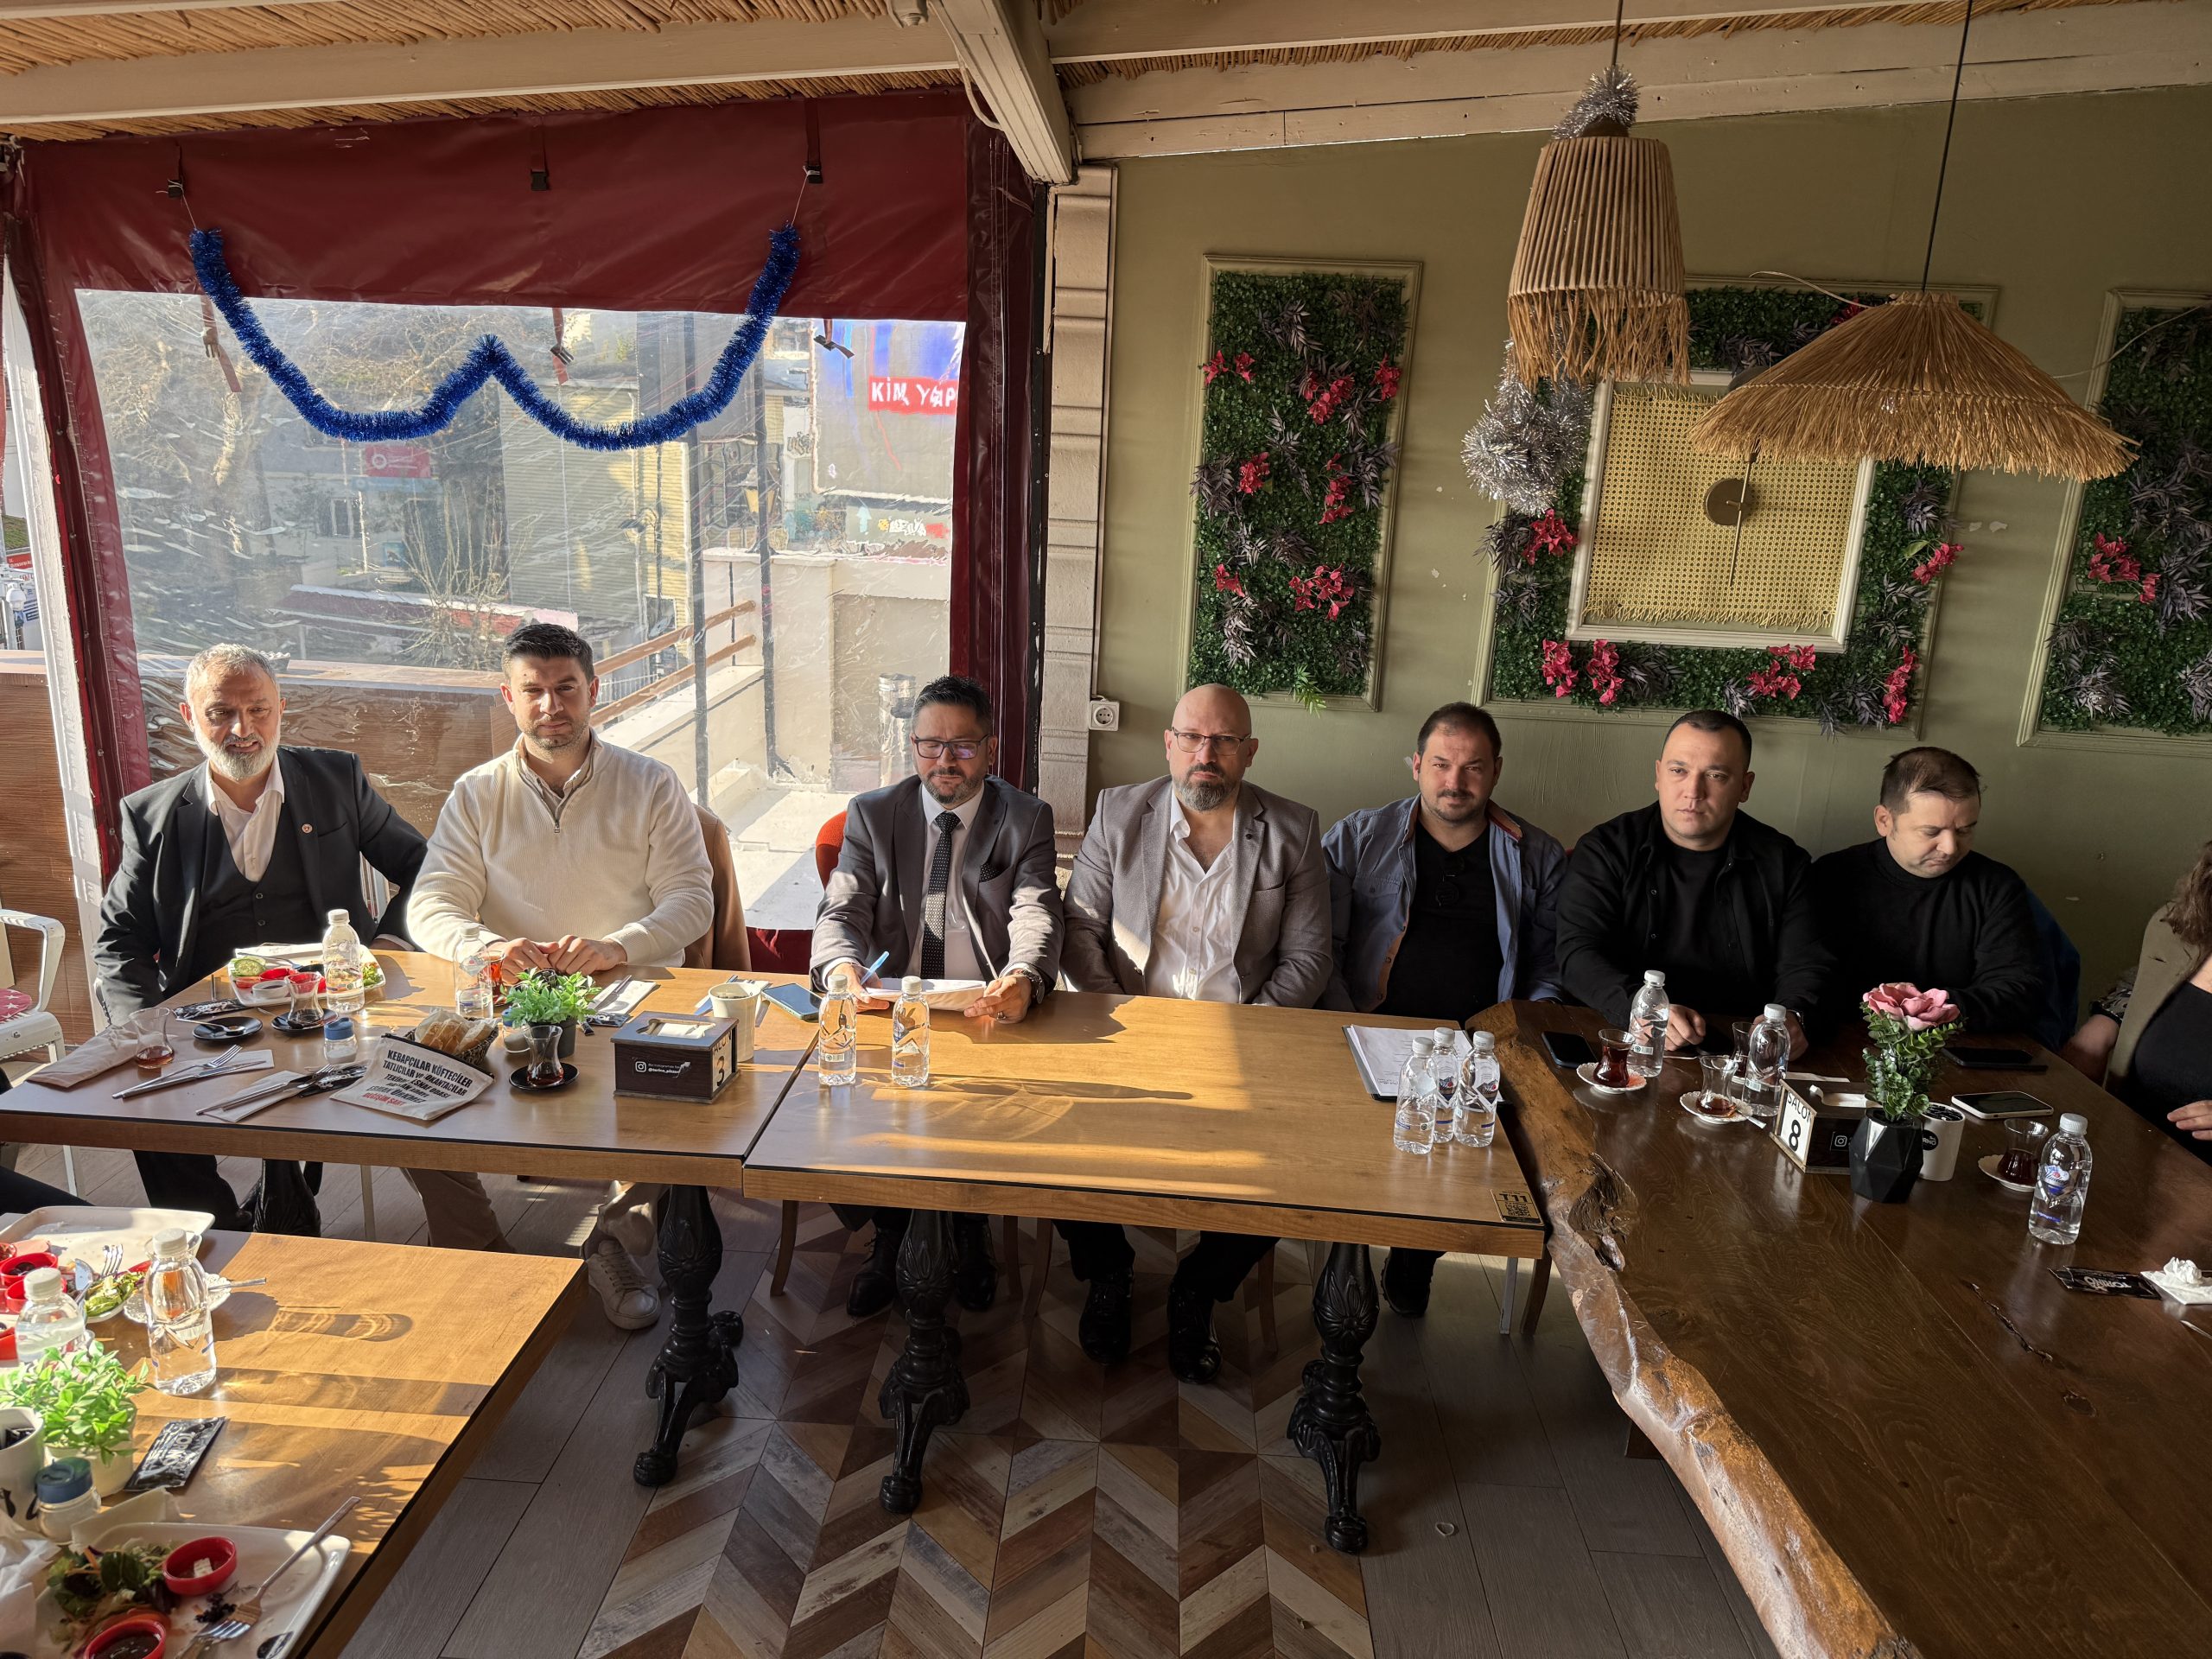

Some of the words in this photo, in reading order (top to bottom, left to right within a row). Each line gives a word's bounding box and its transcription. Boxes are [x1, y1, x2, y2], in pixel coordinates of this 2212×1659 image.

[713, 1029, 731, 1053] ALON
[383, 1060, 416, 1078] TATLICILAR
[387, 1050, 431, 1072] KEBAPÇILAR
[431, 1064, 474, 1088] KÖFTECİLER
[716, 1055, 725, 1086] 3
[1789, 1119, 1802, 1152] 8
